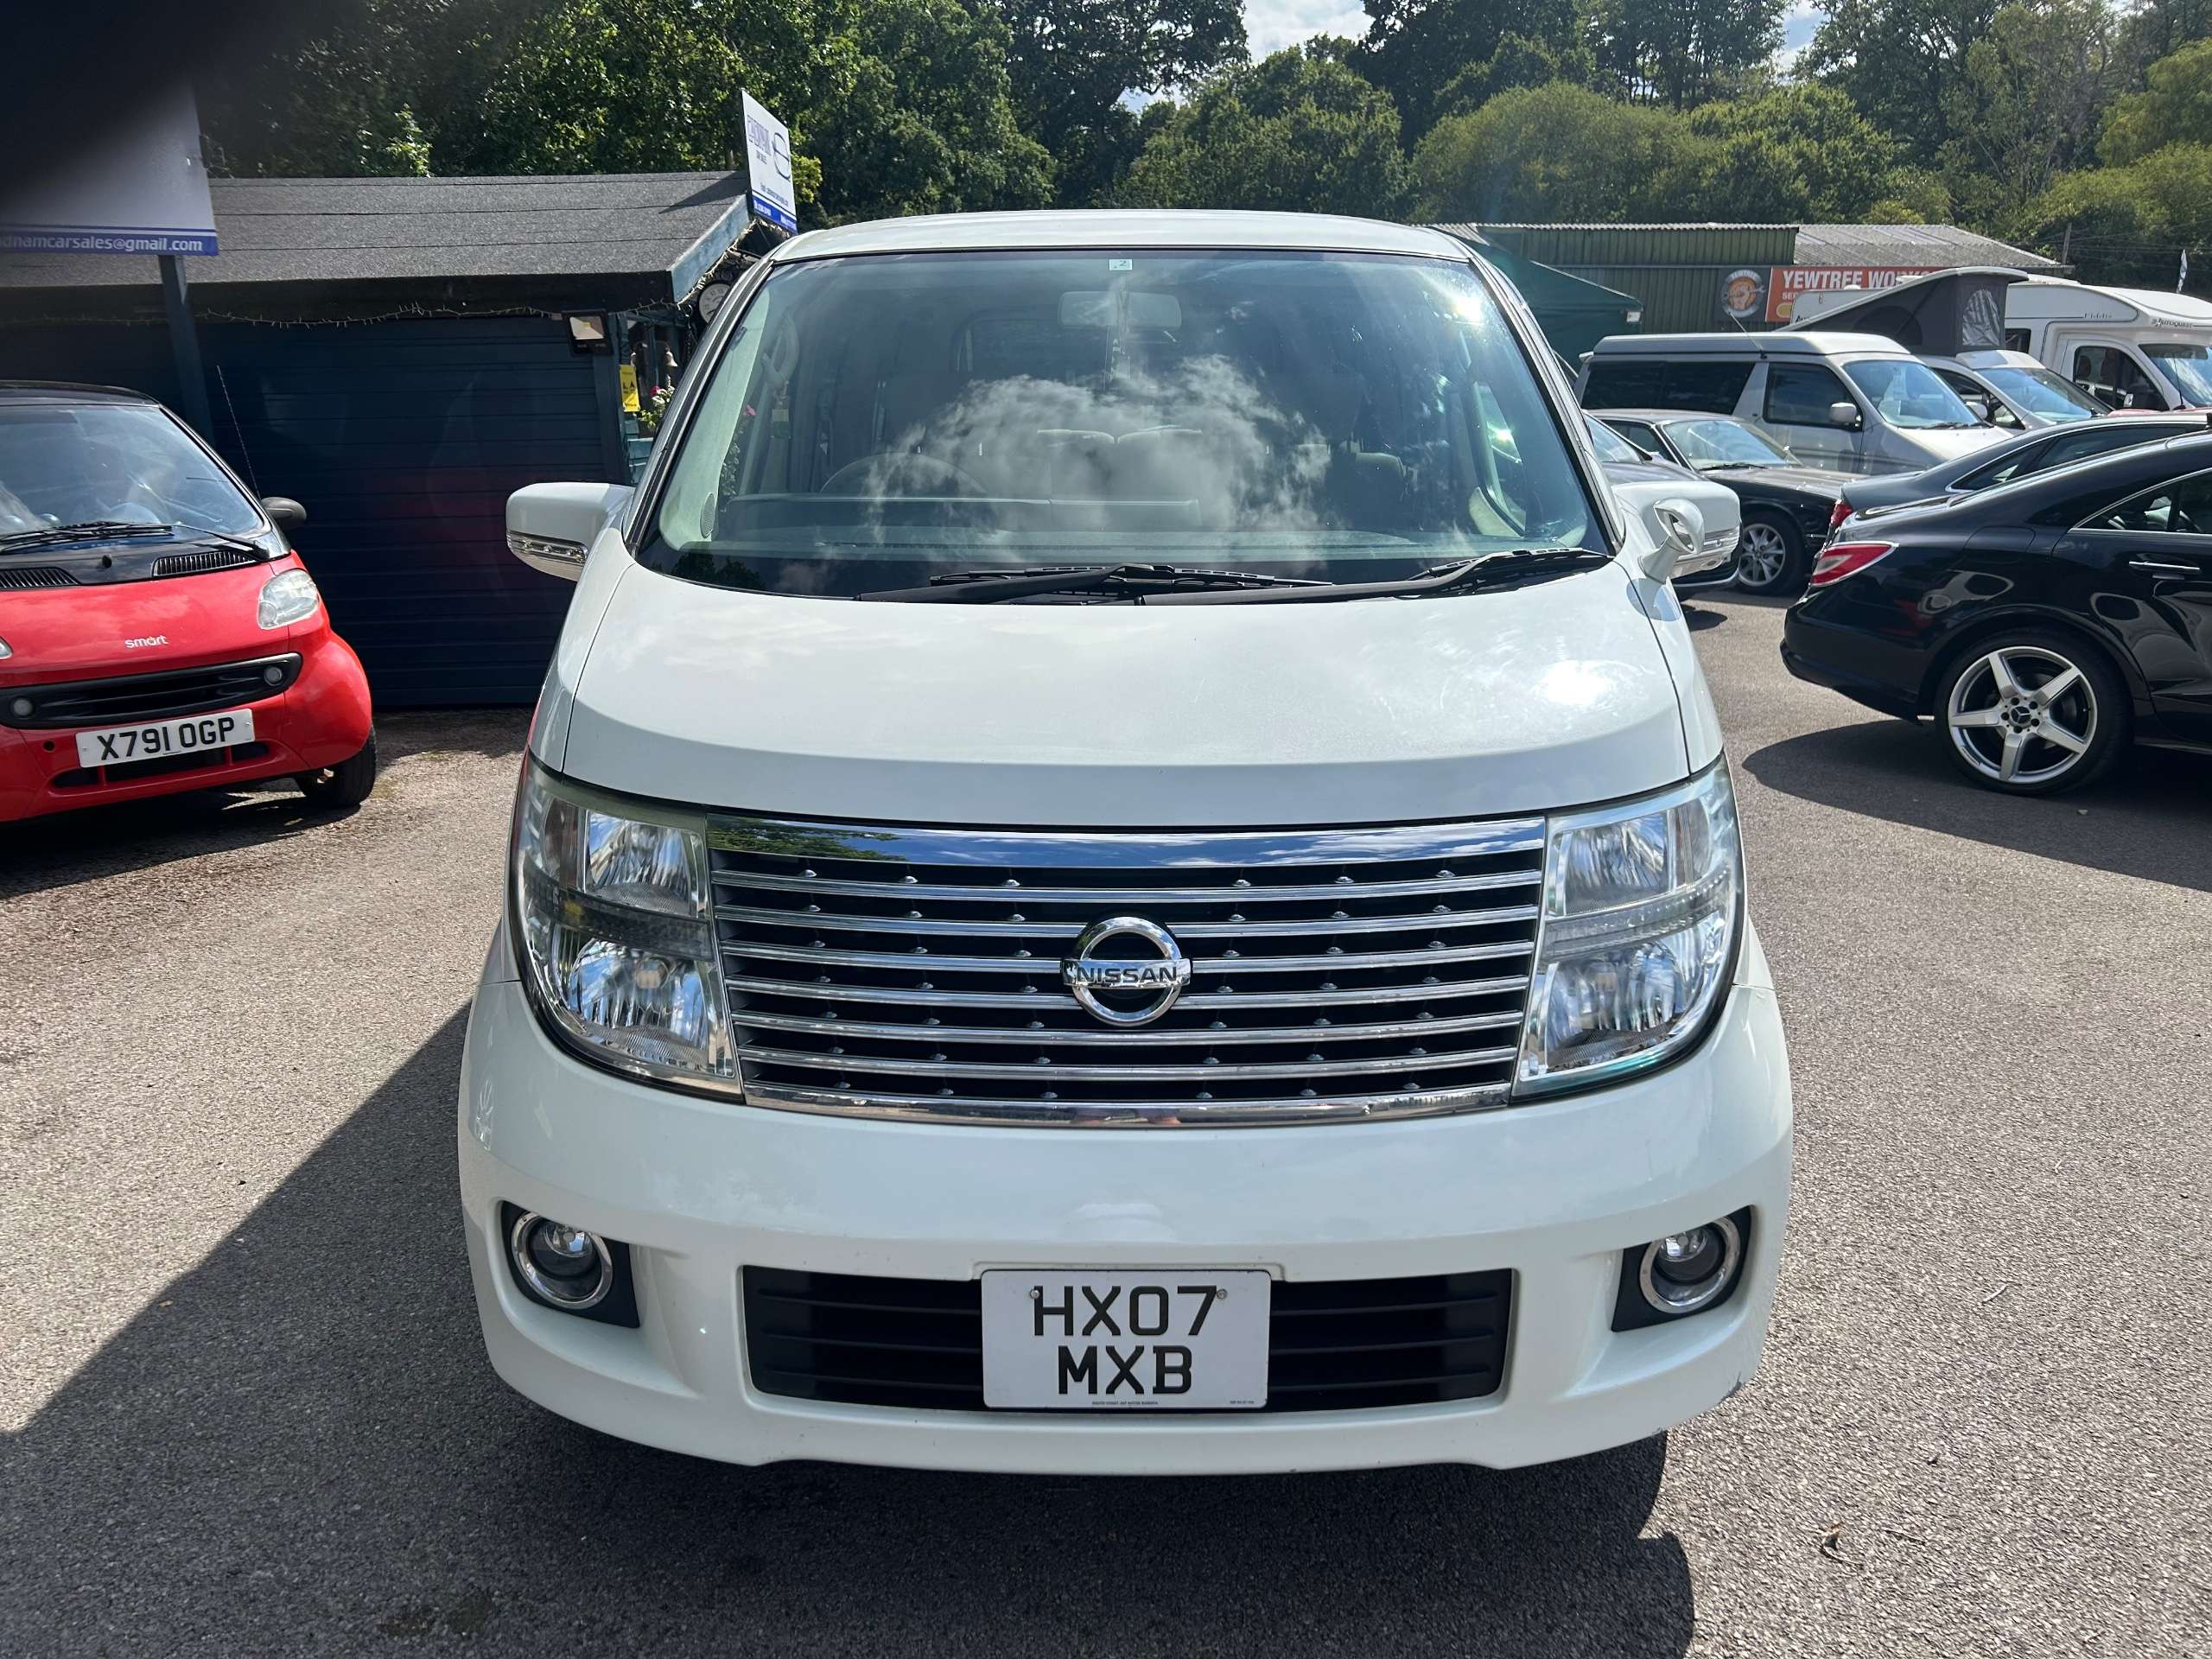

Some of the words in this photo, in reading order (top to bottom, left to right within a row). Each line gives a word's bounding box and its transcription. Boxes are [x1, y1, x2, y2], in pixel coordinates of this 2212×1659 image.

[0, 235, 203, 251] dnamcarsales@gmail.com
[1783, 270, 1862, 289] YEWTREE
[124, 634, 168, 648] smart
[97, 726, 171, 761] X791
[178, 716, 235, 748] OGP
[1077, 966, 1177, 983] NISSAN
[1033, 1285, 1217, 1336] HX07
[1058, 1345, 1192, 1395] MXB
